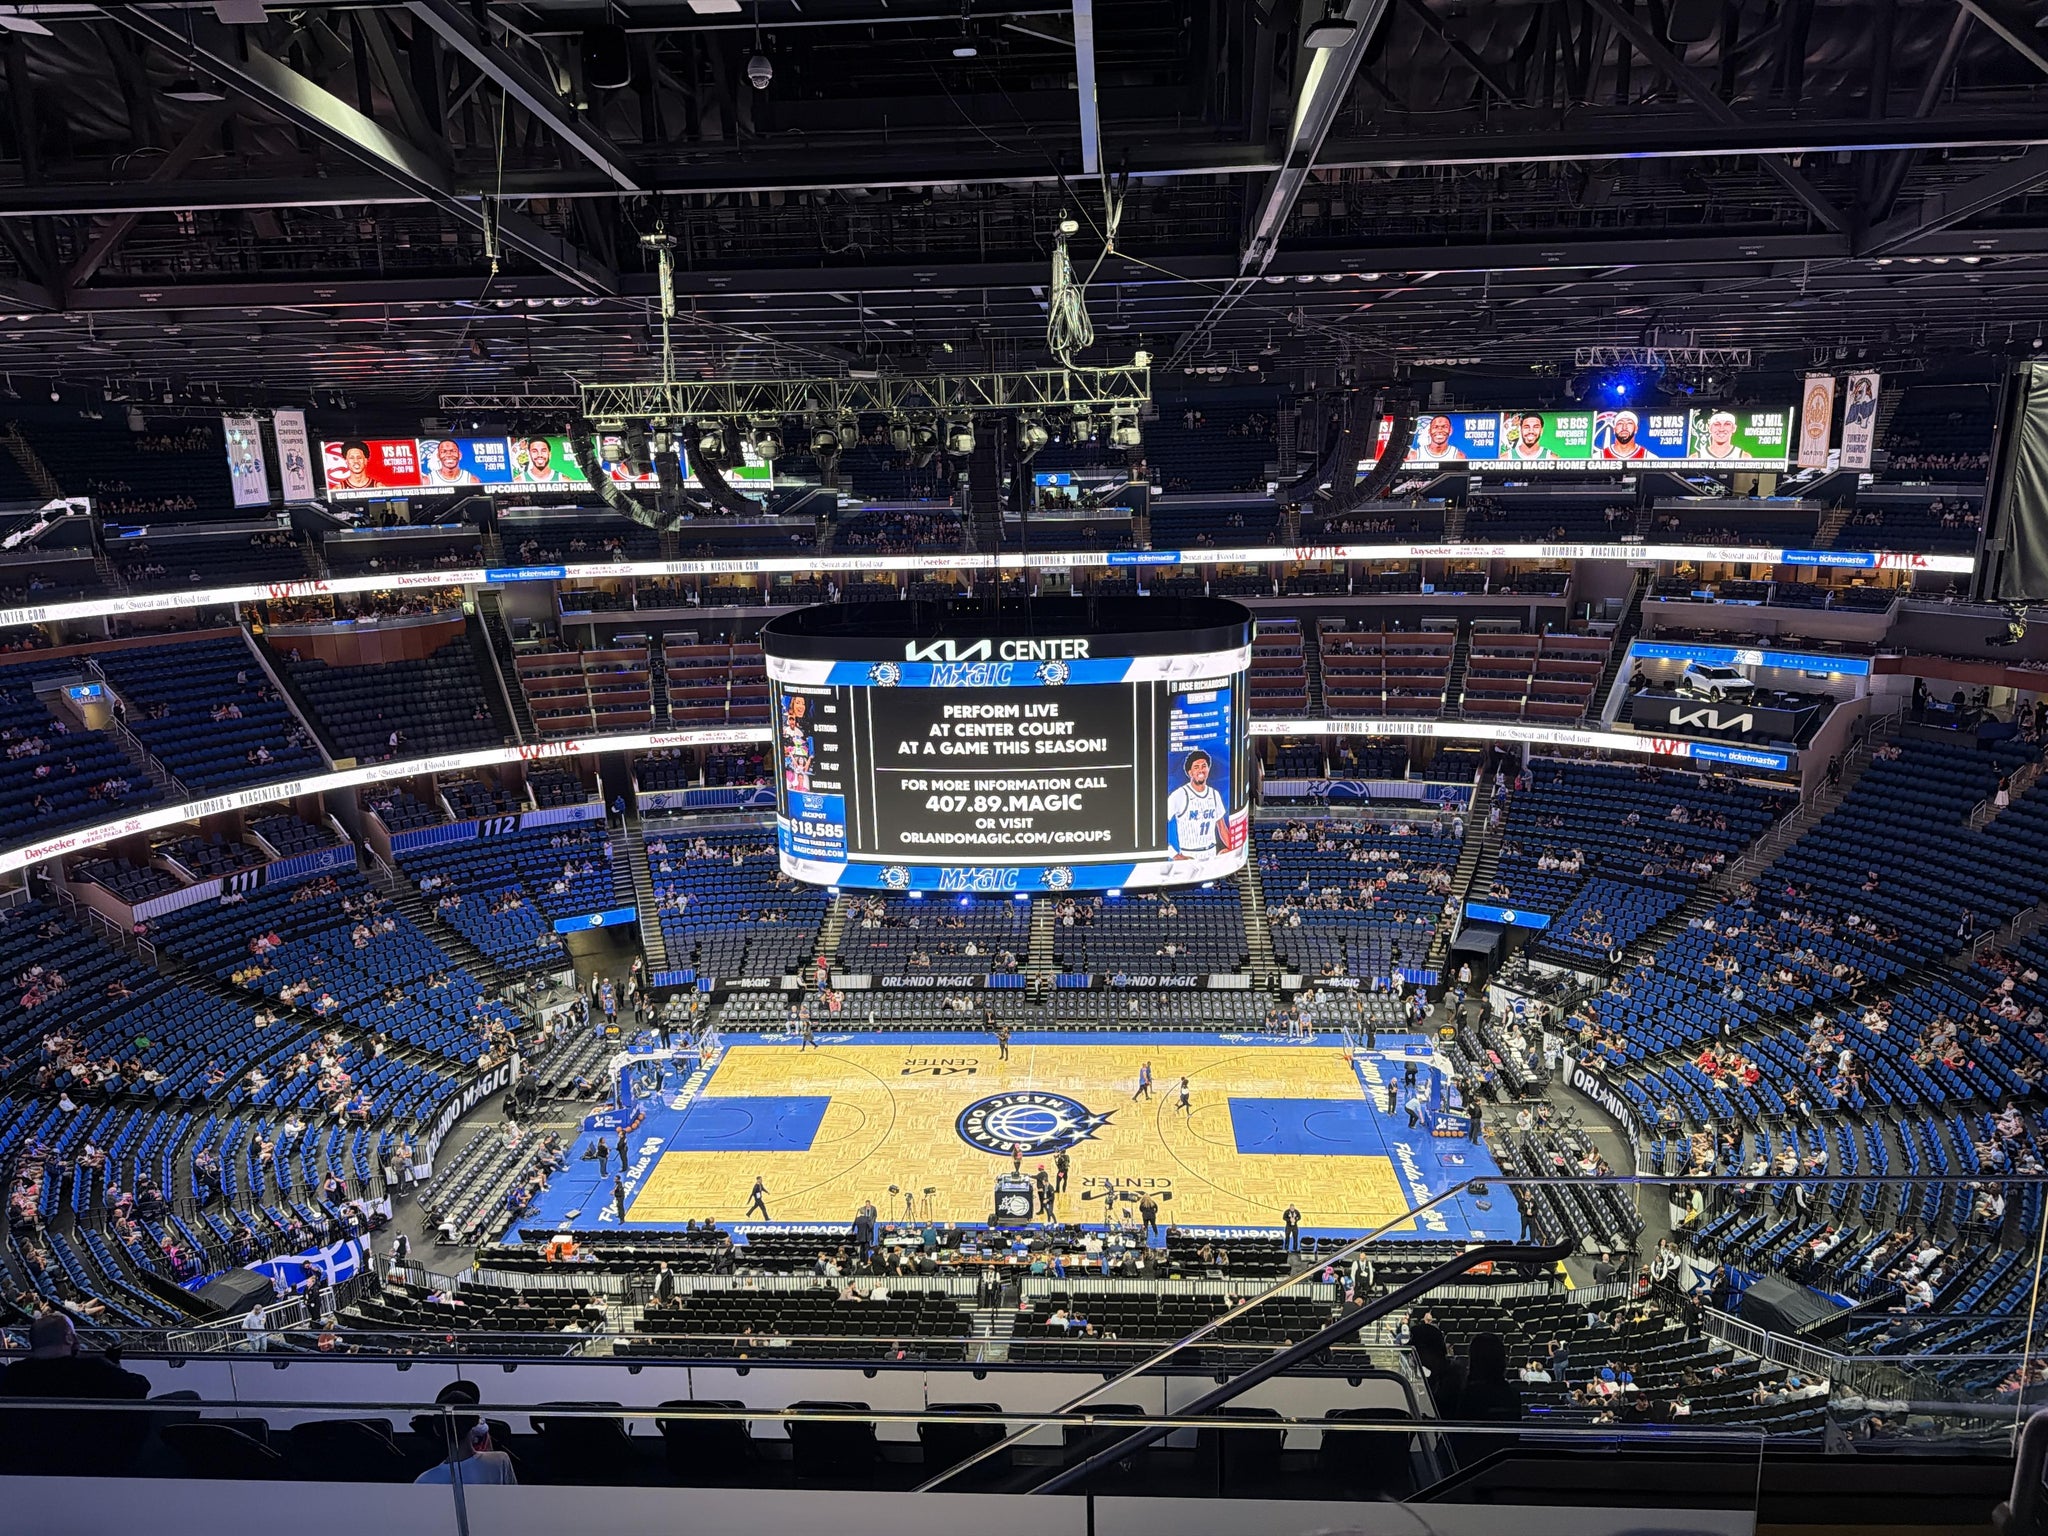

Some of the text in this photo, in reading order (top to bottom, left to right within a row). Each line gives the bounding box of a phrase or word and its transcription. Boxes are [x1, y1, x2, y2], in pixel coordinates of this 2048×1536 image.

[1464, 418, 1477, 430] VS
[1557, 417, 1588, 430] VS BOS
[1649, 415, 1684, 428] VS WAS
[1751, 414, 1784, 427] VS MIL
[1485, 438, 1494, 446] PM
[1577, 437, 1587, 446] PM
[1673, 436, 1683, 445] PM
[381, 445, 413, 458] VS ATL
[473, 443, 489, 455] VS
[404, 465, 415, 473] PM
[1468, 460, 1623, 471] UPCOMING MAGIC HOME GAMES
[485, 481, 593, 495] UPCOMING MAGIC HOM
[1137, 554, 1176, 562] ticketmaster
[1410, 547, 1451, 556] Dayseeker
[1541, 547, 1577, 557] NOVEMBER
[1590, 547, 1646, 557] KIACENTER.COM
[1819, 555, 1869, 565] ticketmaster
[397, 575, 442, 585] Dayseeker
[518, 569, 562, 578] ticketmaster
[156, 598, 170, 607] and
[197, 595, 211, 603] tour
[905, 639, 1090, 662] KIA CENTER
[930, 662, 1014, 687] MAGIC
[1178, 681, 1194, 692] JASE
[943, 703, 1059, 719] PERFORM LIVE
[929, 722, 1075, 737] AT CENTER COURT
[1326, 722, 1434, 734] NOVEMBER 5 KIACENTER.COM
[650, 734, 693, 744] Dayseeker
[898, 739, 1107, 756] AT A GAME THIS SEASON!
[1695, 748, 1780, 766] Powered by ticketmaster
[901, 777, 1108, 792] FOR MORE INFORMATION CALL
[183, 782, 302, 818] NOVEMBER 5 KIACENTER.COM
[925, 794, 1083, 813] 407.89.MAGIC
[801, 811, 827, 820] JACKPOT
[483, 816, 516, 837] 112
[791, 818, 844, 838] $18,585
[975, 817, 1034, 829] OR VISIT
[1199, 821, 1211, 836] 11
[900, 830, 1112, 845] ORLANDOMAGIC.COM/GROUPS
[24, 838, 77, 860] Dayseeker
[229, 869, 259, 892] 111
[939, 868, 1020, 891] MAGIC
[741, 978, 771, 988] MAGIC
[881, 975, 975, 987] ORLANDO MAGIC
[1158, 975, 1198, 987] MAGIC
[1329, 977, 1360, 988] MAGIC
[904, 1058, 979, 1066] CENTER
[462, 1063, 510, 1112] MAGIC
[990, 1095, 1064, 1109] MAGIC
[1573, 1068, 1630, 1128] ORLANDO
[967, 1109, 1032, 1152] ORLANDO
[626, 1156, 652, 1180] Blue
[1393, 1141, 1436, 1206] Florida Blue
[1082, 1177, 1172, 1188] CENTER
[733, 1224, 853, 1236] AdventHealth
